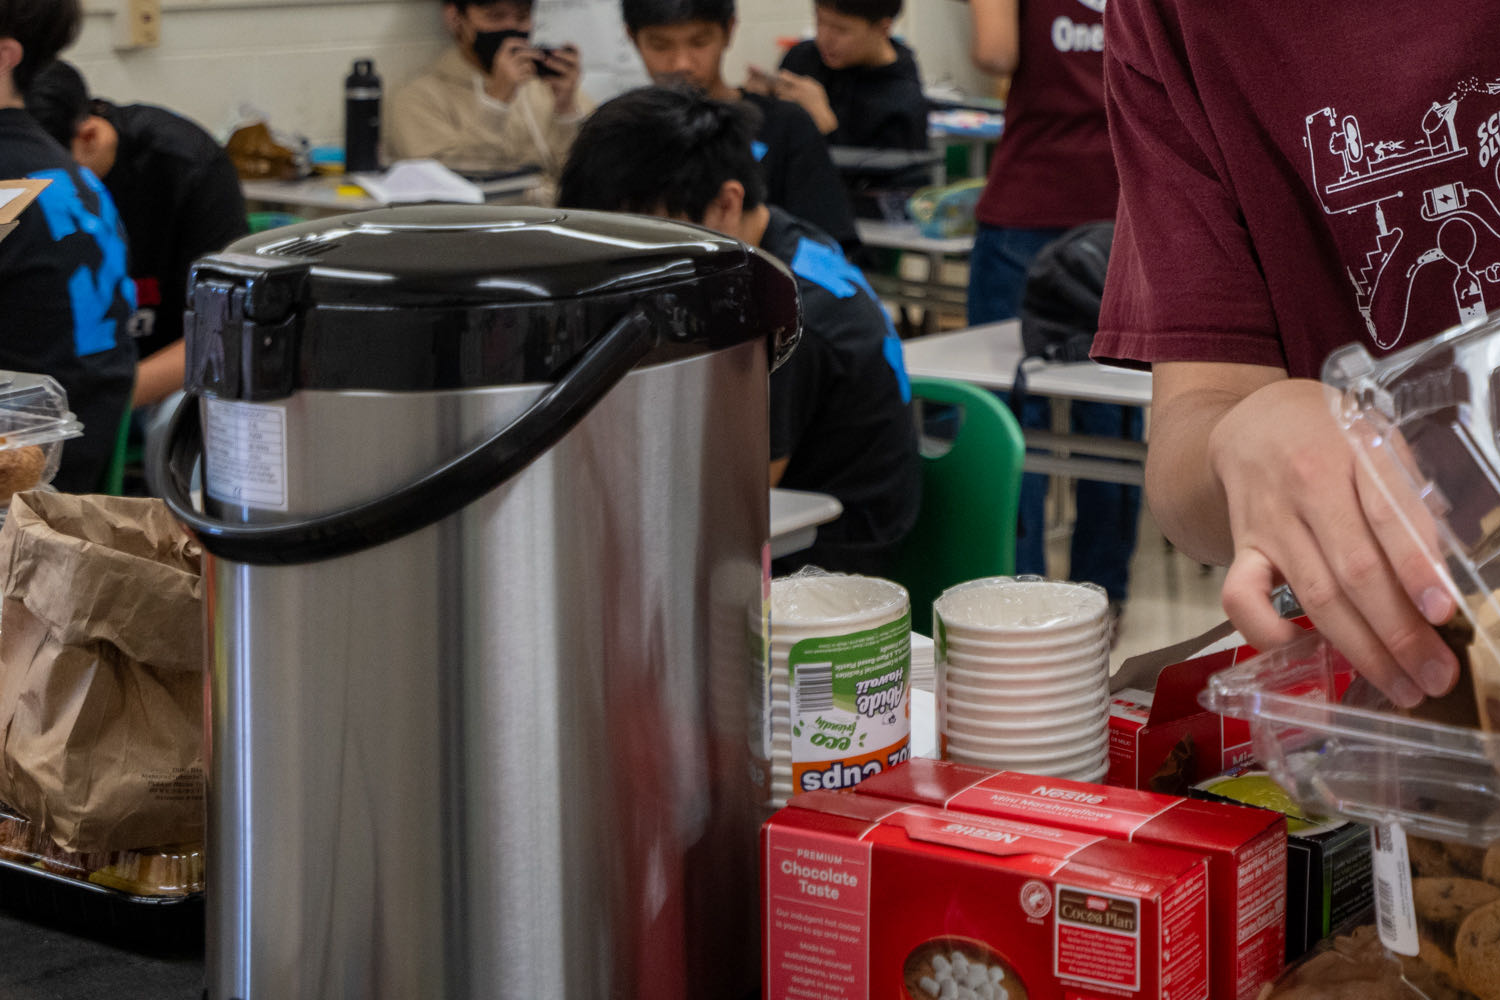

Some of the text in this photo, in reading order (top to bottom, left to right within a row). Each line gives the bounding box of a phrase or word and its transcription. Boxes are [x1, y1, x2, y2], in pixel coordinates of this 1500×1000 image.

[856, 665, 903, 695] Hawaii
[856, 679, 904, 718] Abide
[815, 715, 857, 737] friendly
[810, 732, 852, 751] eco
[801, 762, 883, 792] Cups
[797, 848, 843, 865] PREMIUM
[781, 860, 858, 887] Chocolate
[798, 879, 840, 900] Taste
[1060, 903, 1104, 926] Cocoa
[1104, 912, 1135, 932] Plan
